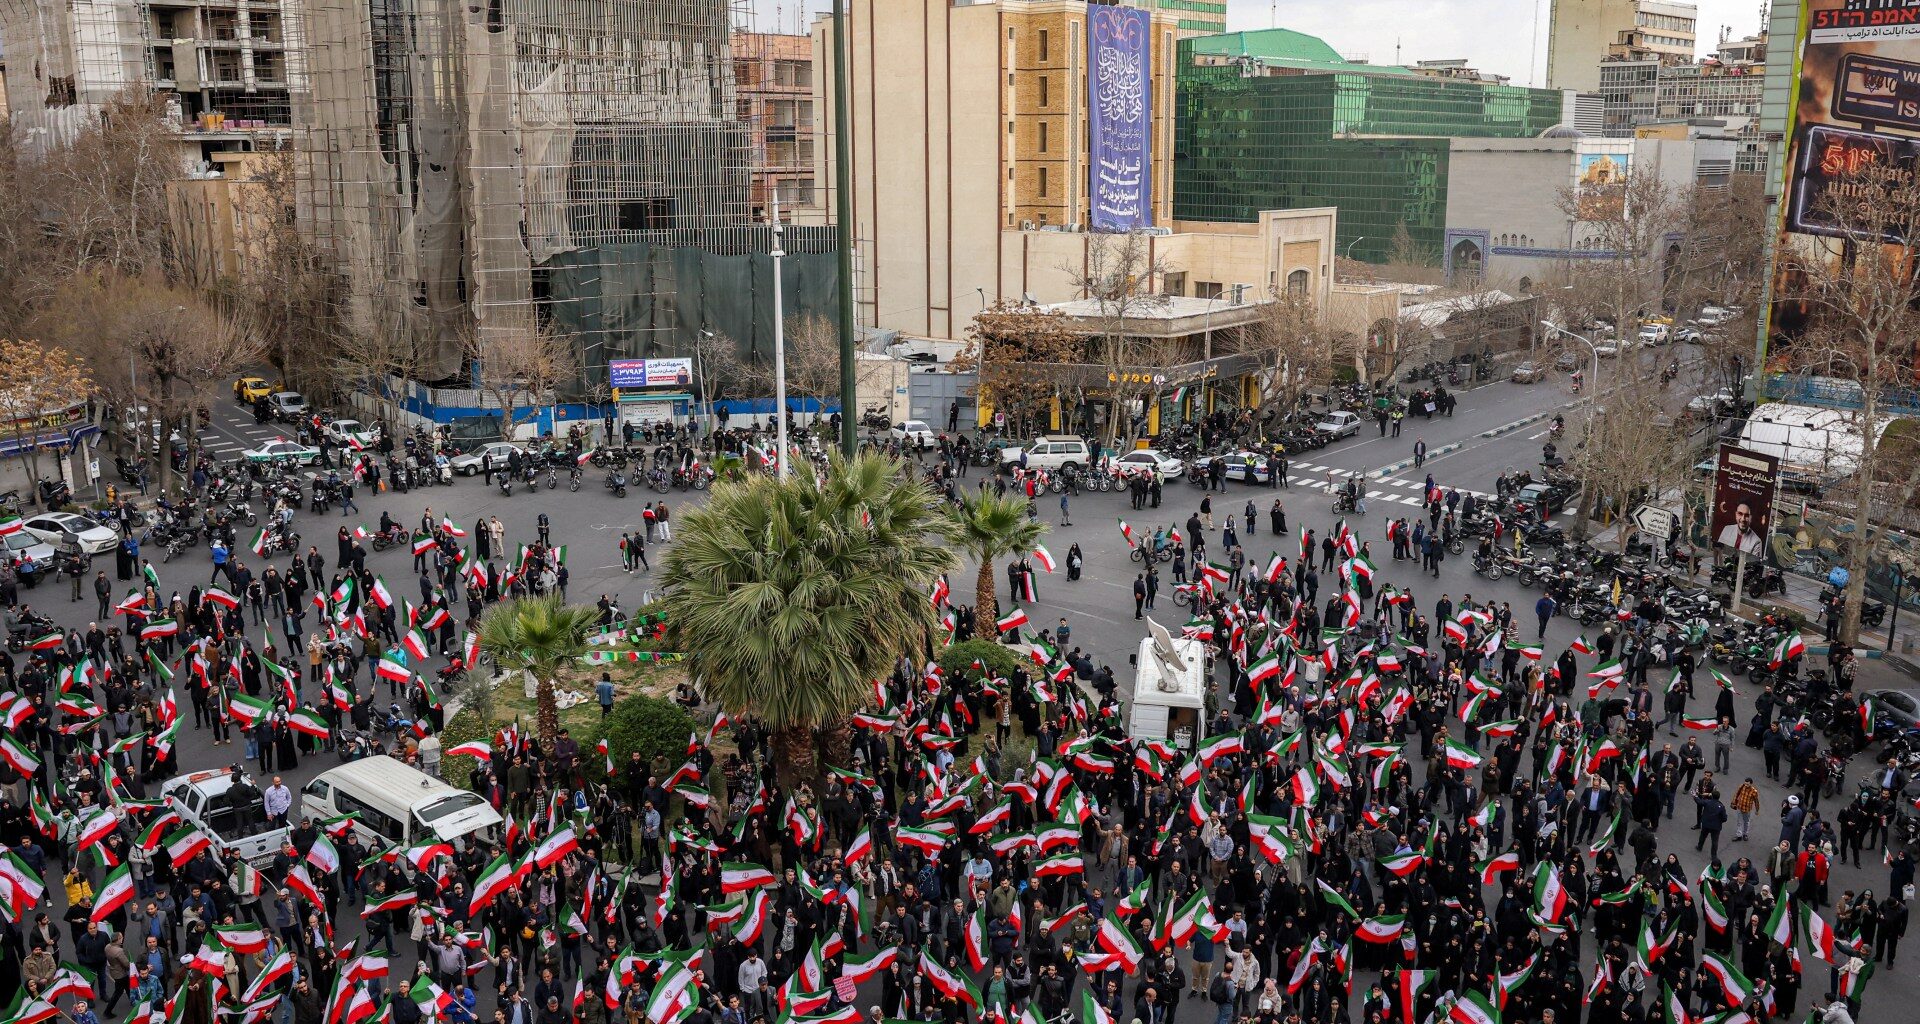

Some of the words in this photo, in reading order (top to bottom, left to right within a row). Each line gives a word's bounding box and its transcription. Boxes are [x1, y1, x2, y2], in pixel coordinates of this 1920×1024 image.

[1870, 8, 1919, 25] אמפ
[1846, 29, 1870, 41] ترامپ
[1898, 99, 1920, 118] IS
[1118, 156, 1141, 175] قرآن
